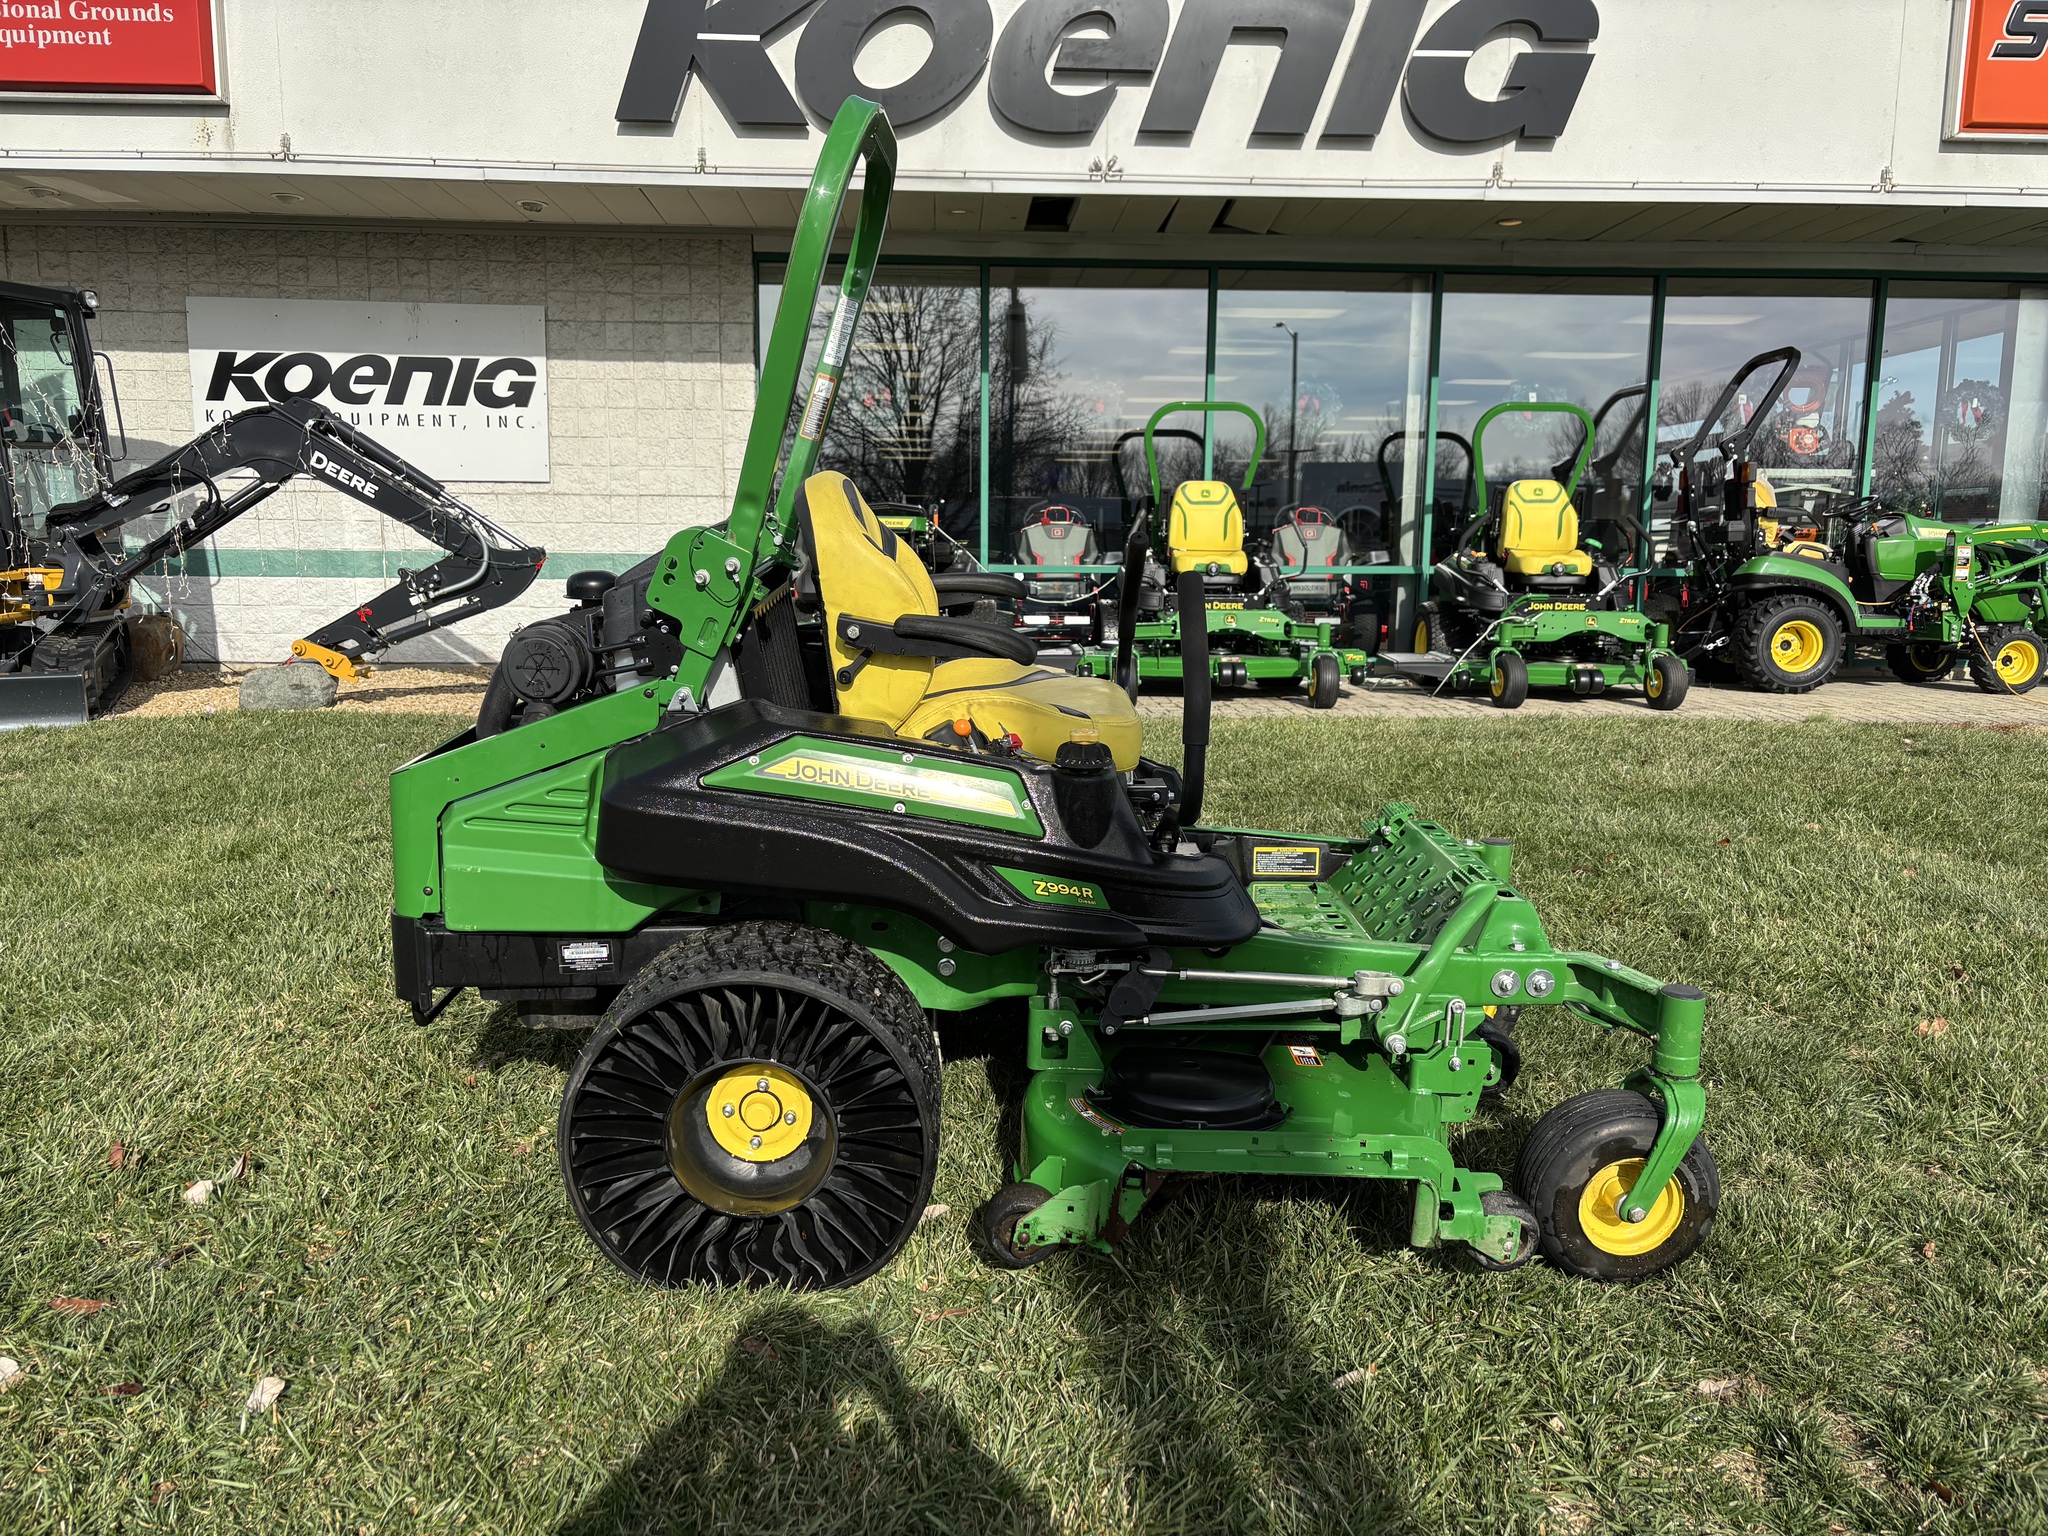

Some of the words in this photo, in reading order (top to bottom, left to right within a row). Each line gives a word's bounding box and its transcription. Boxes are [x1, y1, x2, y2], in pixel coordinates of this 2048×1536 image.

[69, 0, 174, 23] Grounds
[486, 415, 536, 429] INC.
[309, 449, 380, 499] DEERE
[1212, 602, 1244, 610] DEERE
[1528, 602, 1554, 611] JOHN
[1554, 602, 1586, 611] DEERE
[787, 760, 851, 786] JOHN
[856, 772, 931, 799] DEERE
[1032, 880, 1095, 899] Z994R
